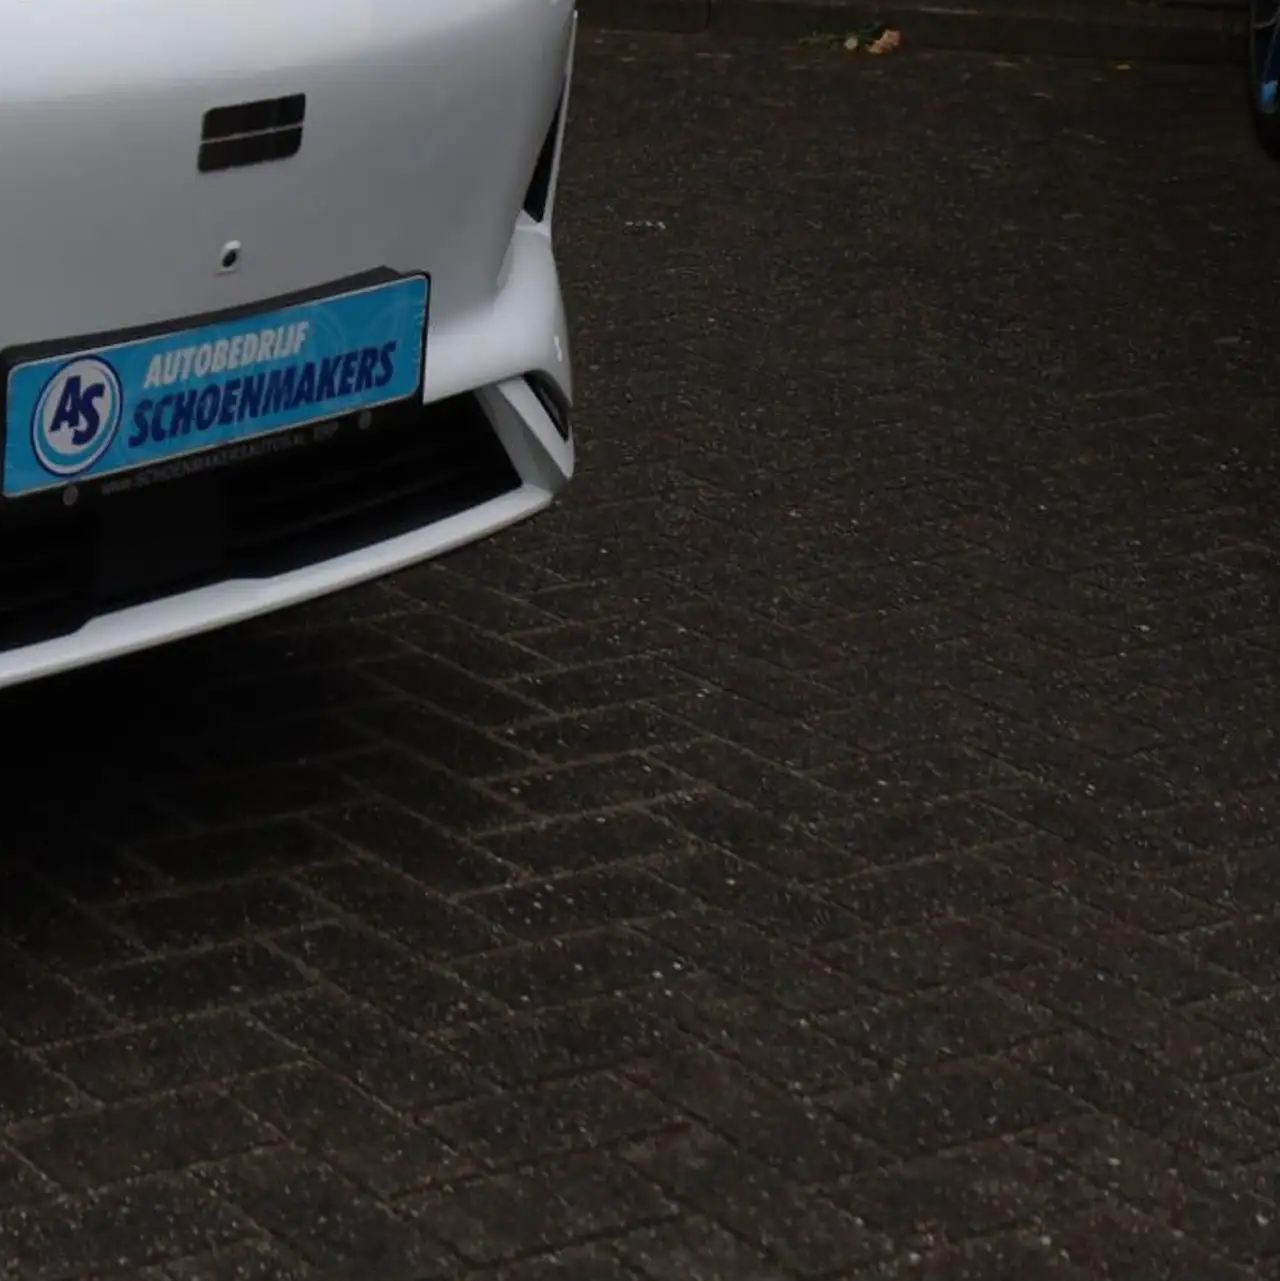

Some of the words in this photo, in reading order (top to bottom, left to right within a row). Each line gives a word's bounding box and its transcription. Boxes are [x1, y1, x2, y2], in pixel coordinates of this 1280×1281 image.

[143, 321, 310, 388] AUTOBEDRIJF
[49, 375, 105, 445] AS
[128, 340, 397, 448] SCHOENMAKERS
